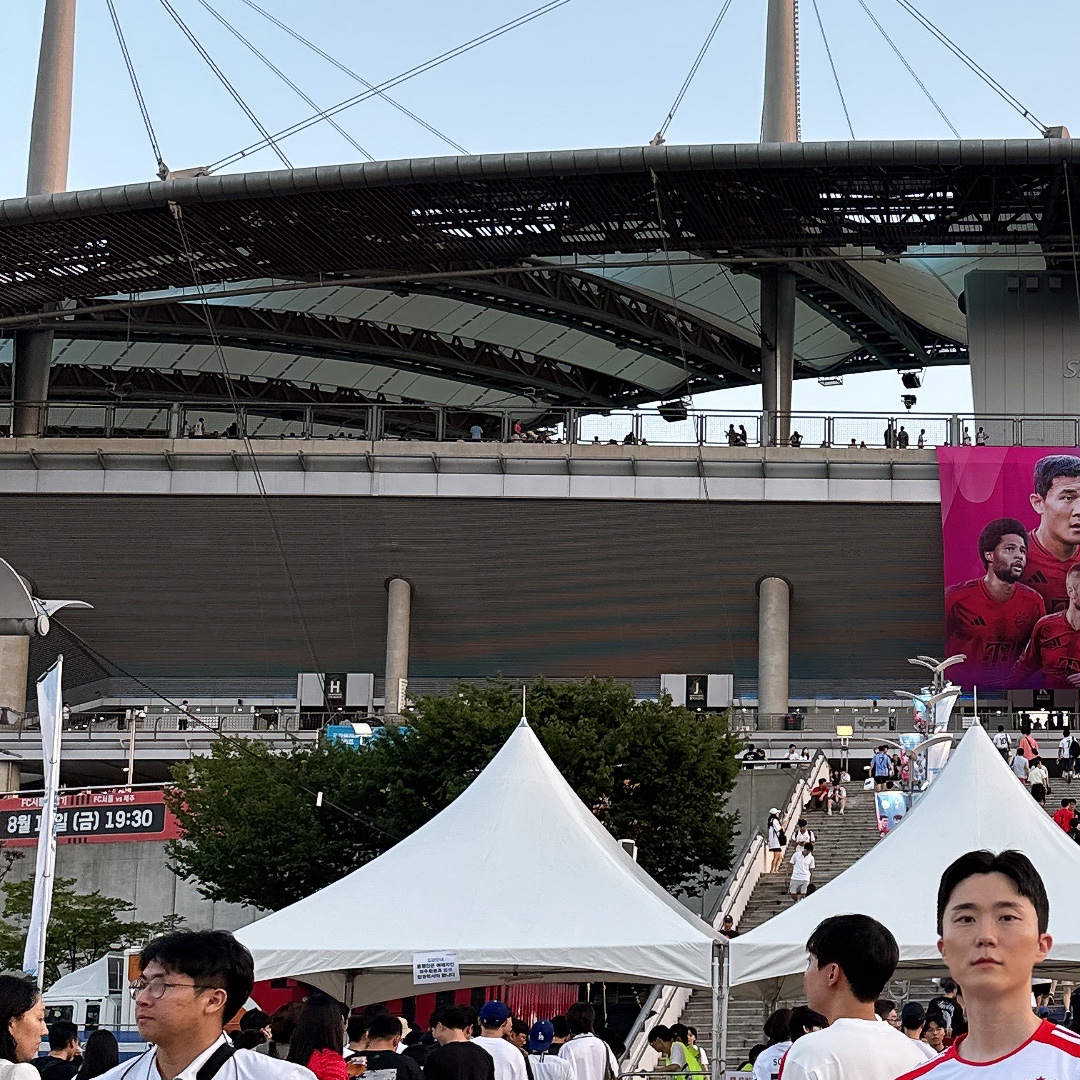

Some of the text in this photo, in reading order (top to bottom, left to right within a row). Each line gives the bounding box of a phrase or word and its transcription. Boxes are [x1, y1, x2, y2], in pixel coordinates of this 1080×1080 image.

[330, 680, 340, 693] H
[7, 809, 153, 835] 8월 1일 (금) 19:30
